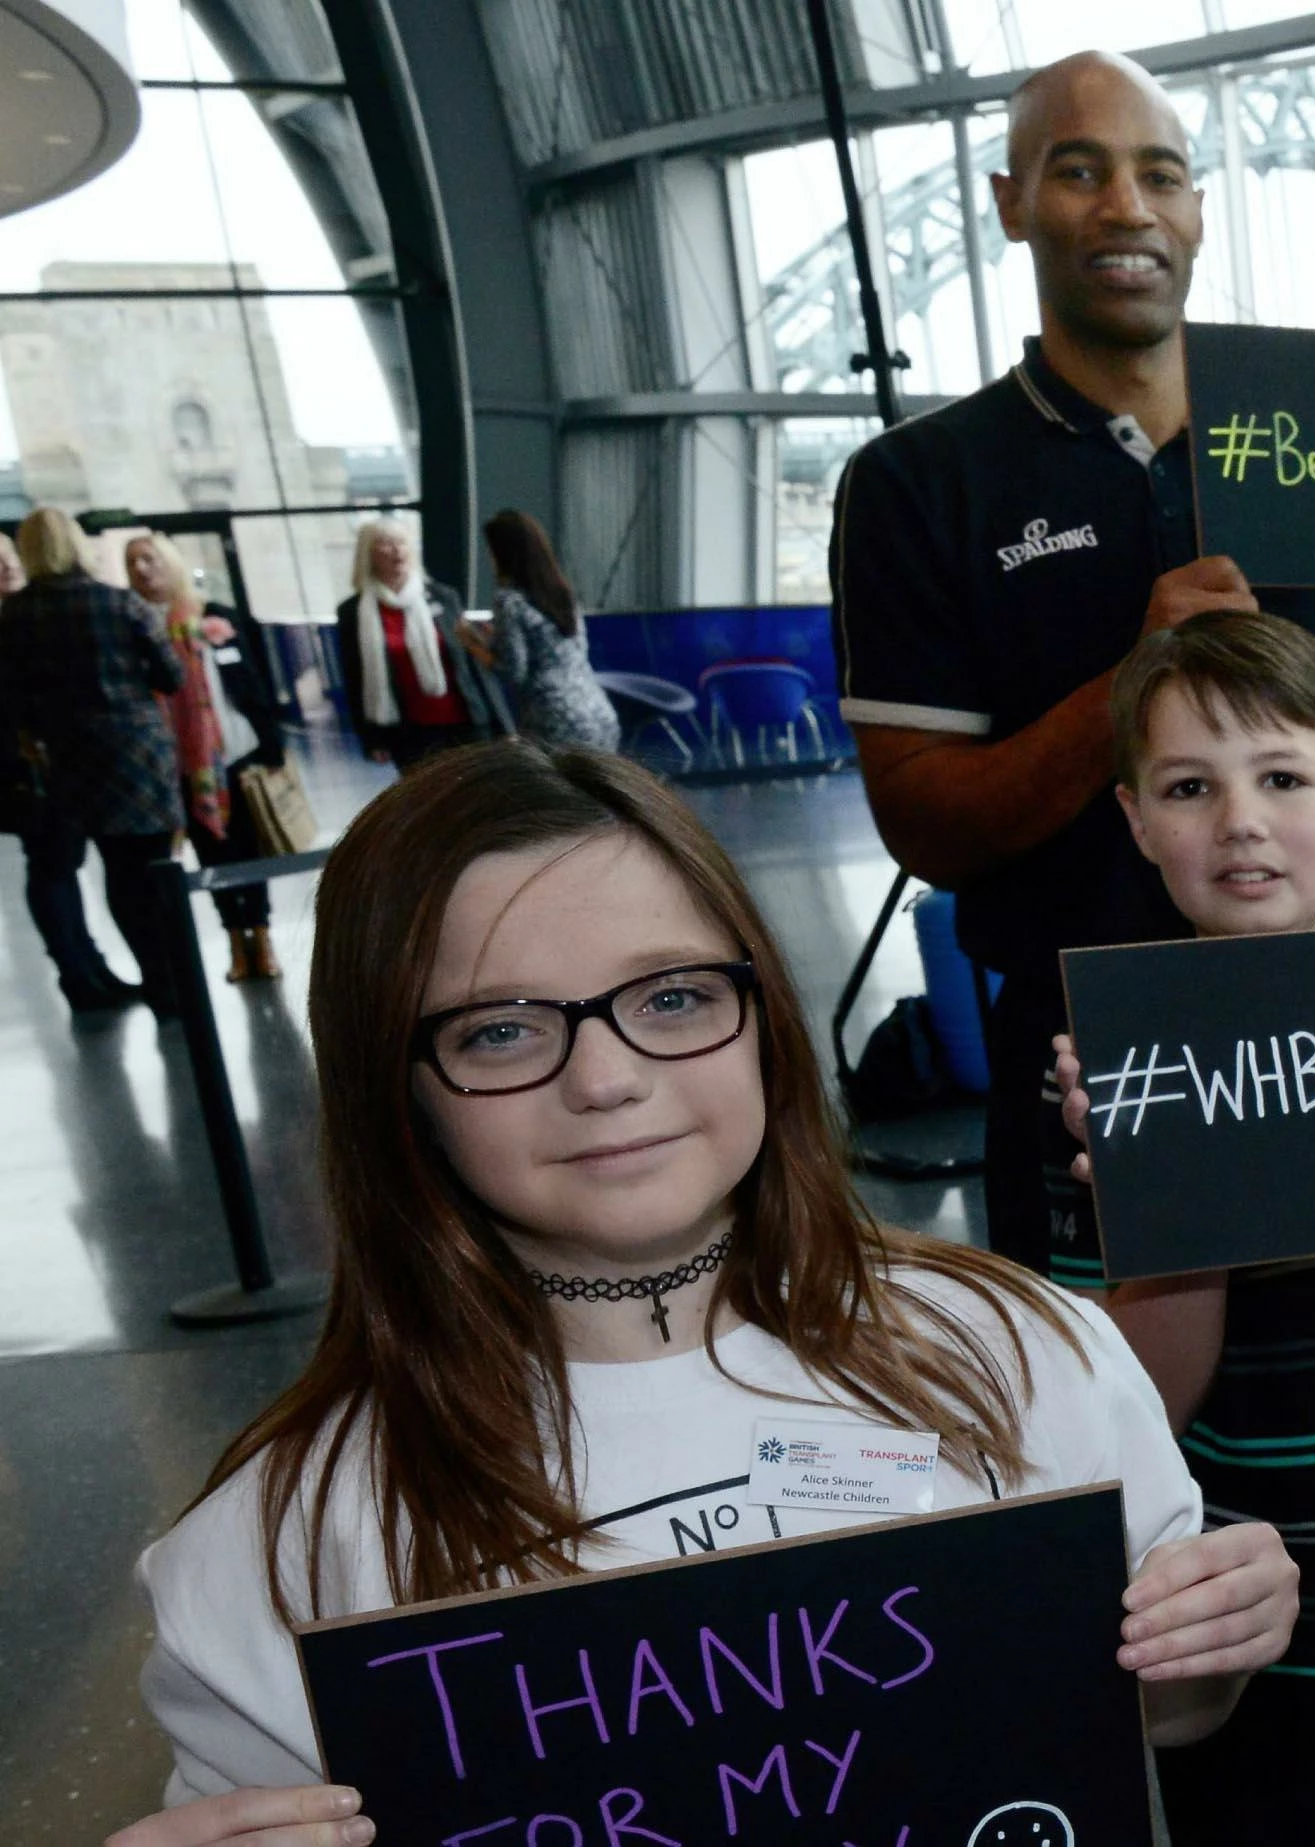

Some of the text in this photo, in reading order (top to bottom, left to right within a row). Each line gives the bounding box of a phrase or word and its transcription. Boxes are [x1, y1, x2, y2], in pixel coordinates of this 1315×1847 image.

[997, 523, 1098, 571] SPALDING
[859, 1449, 936, 1464] TRANSPLANT
[781, 1487, 890, 1505] Newcastle Children
[801, 1474, 875, 1489] Alice Skinner
[367, 1585, 936, 1780] THANKS
[718, 1729, 862, 1837] MY
